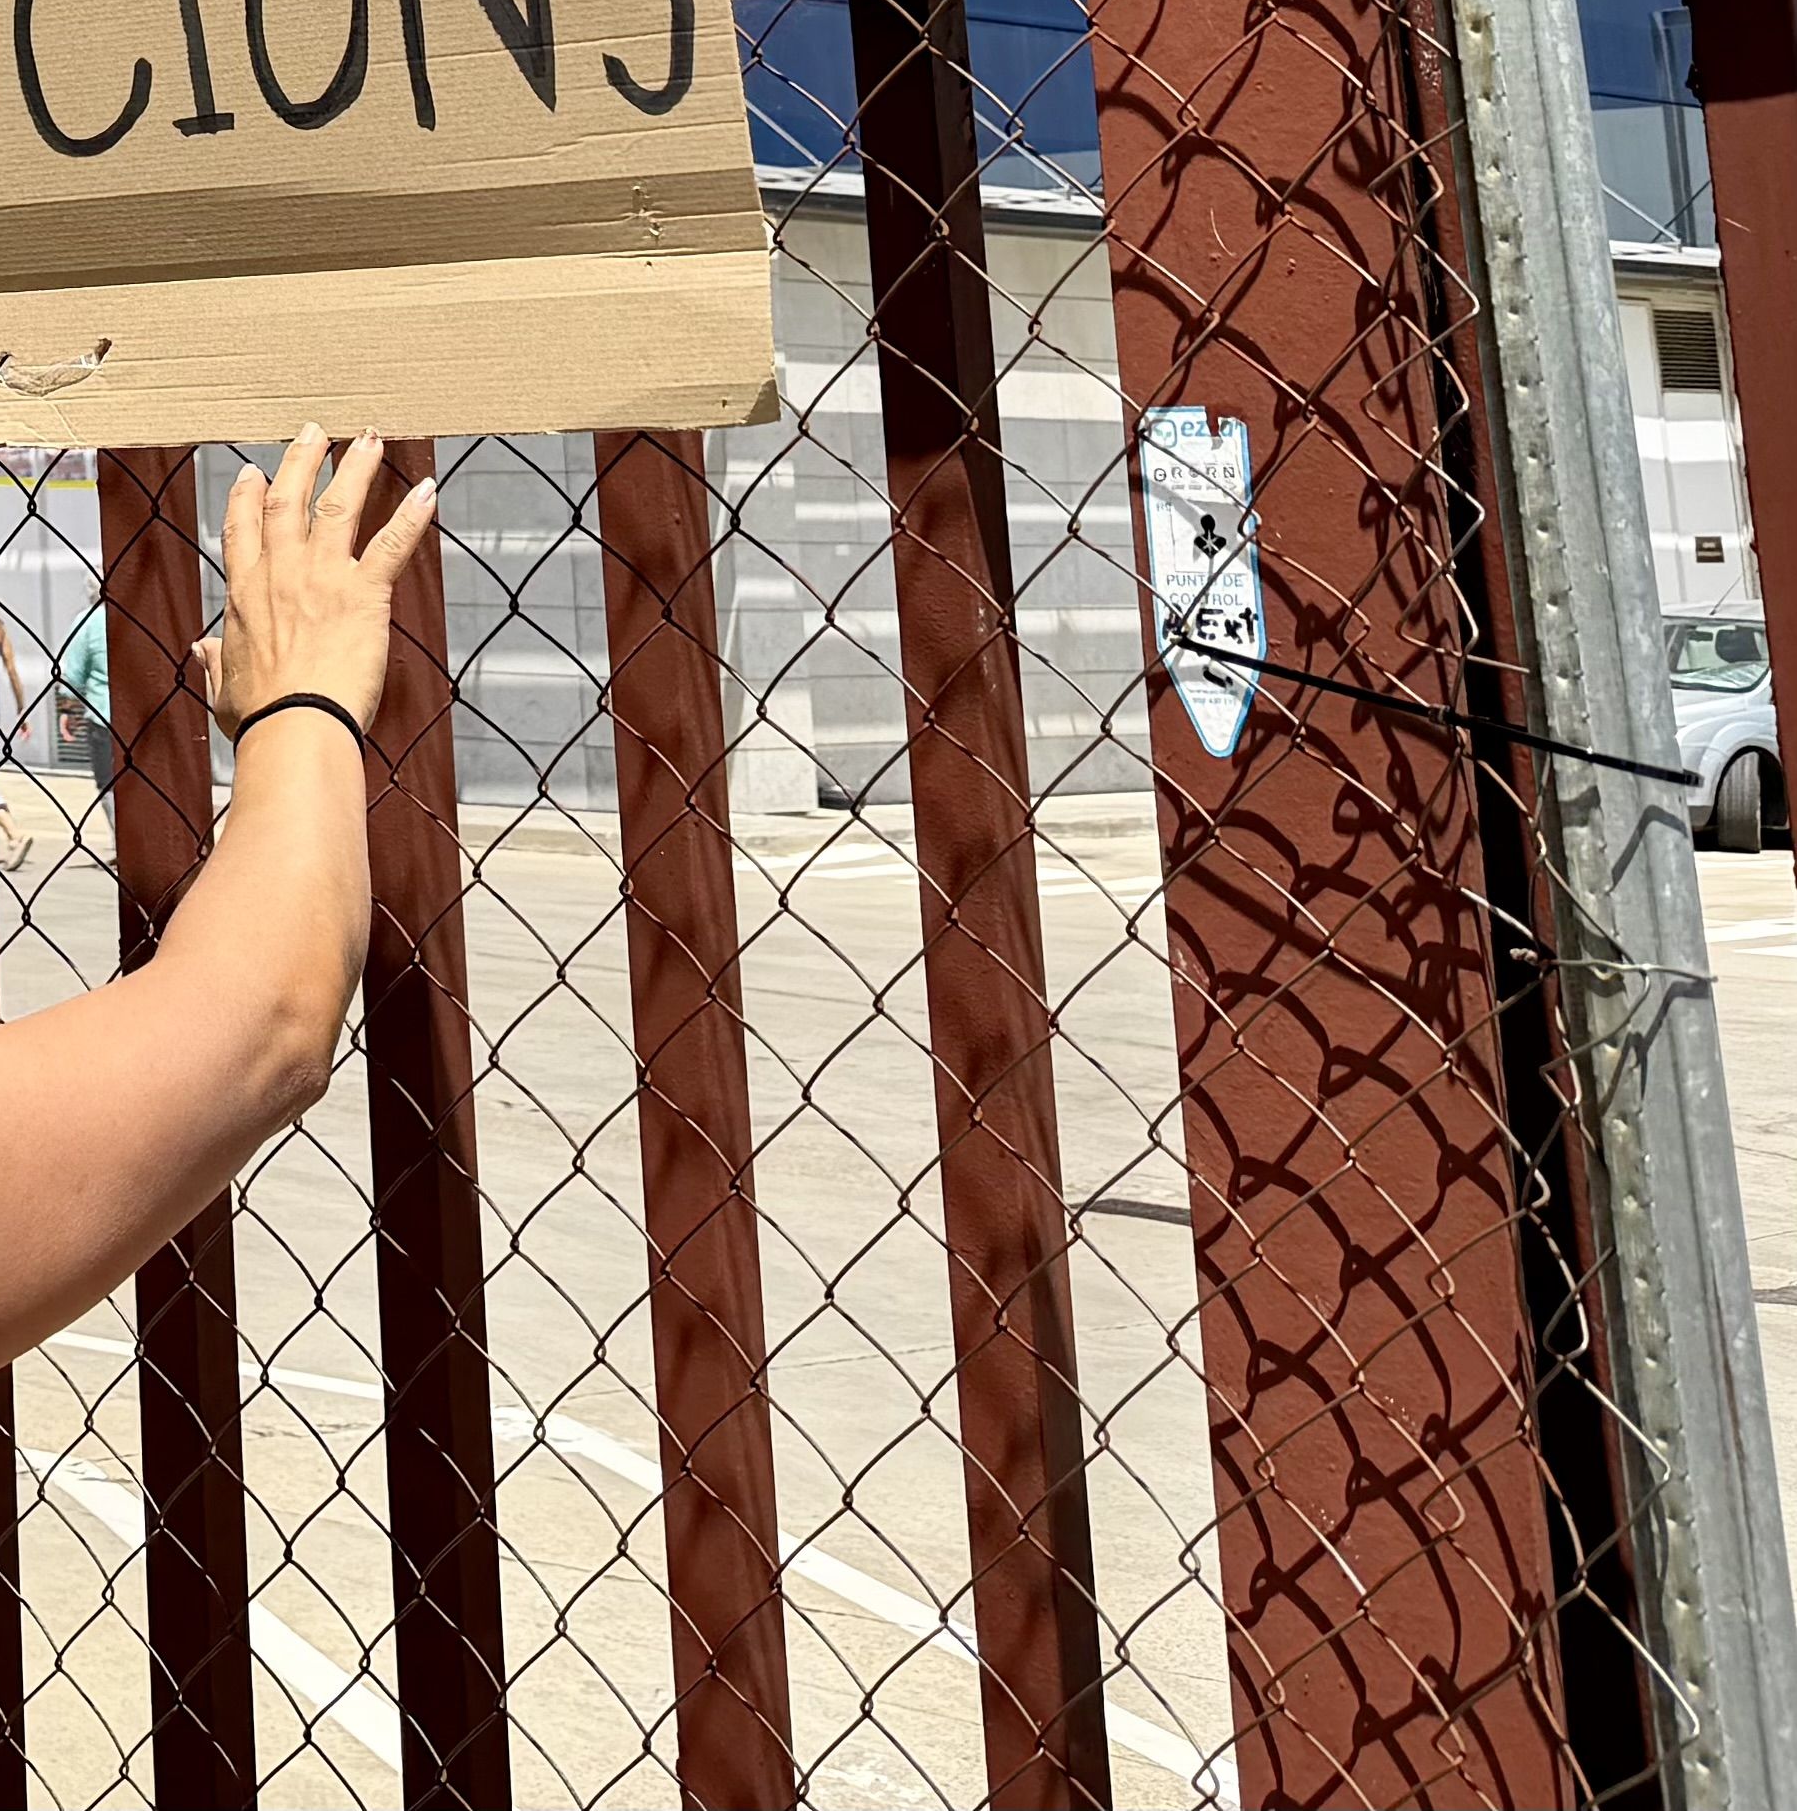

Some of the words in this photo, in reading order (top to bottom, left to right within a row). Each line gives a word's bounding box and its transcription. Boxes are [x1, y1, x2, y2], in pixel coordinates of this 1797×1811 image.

[1181, 420, 1234, 437] eza
[1167, 574, 1218, 586] PUNT
[1223, 574, 1245, 587] DE
[1170, 592, 1243, 605] COTROL
